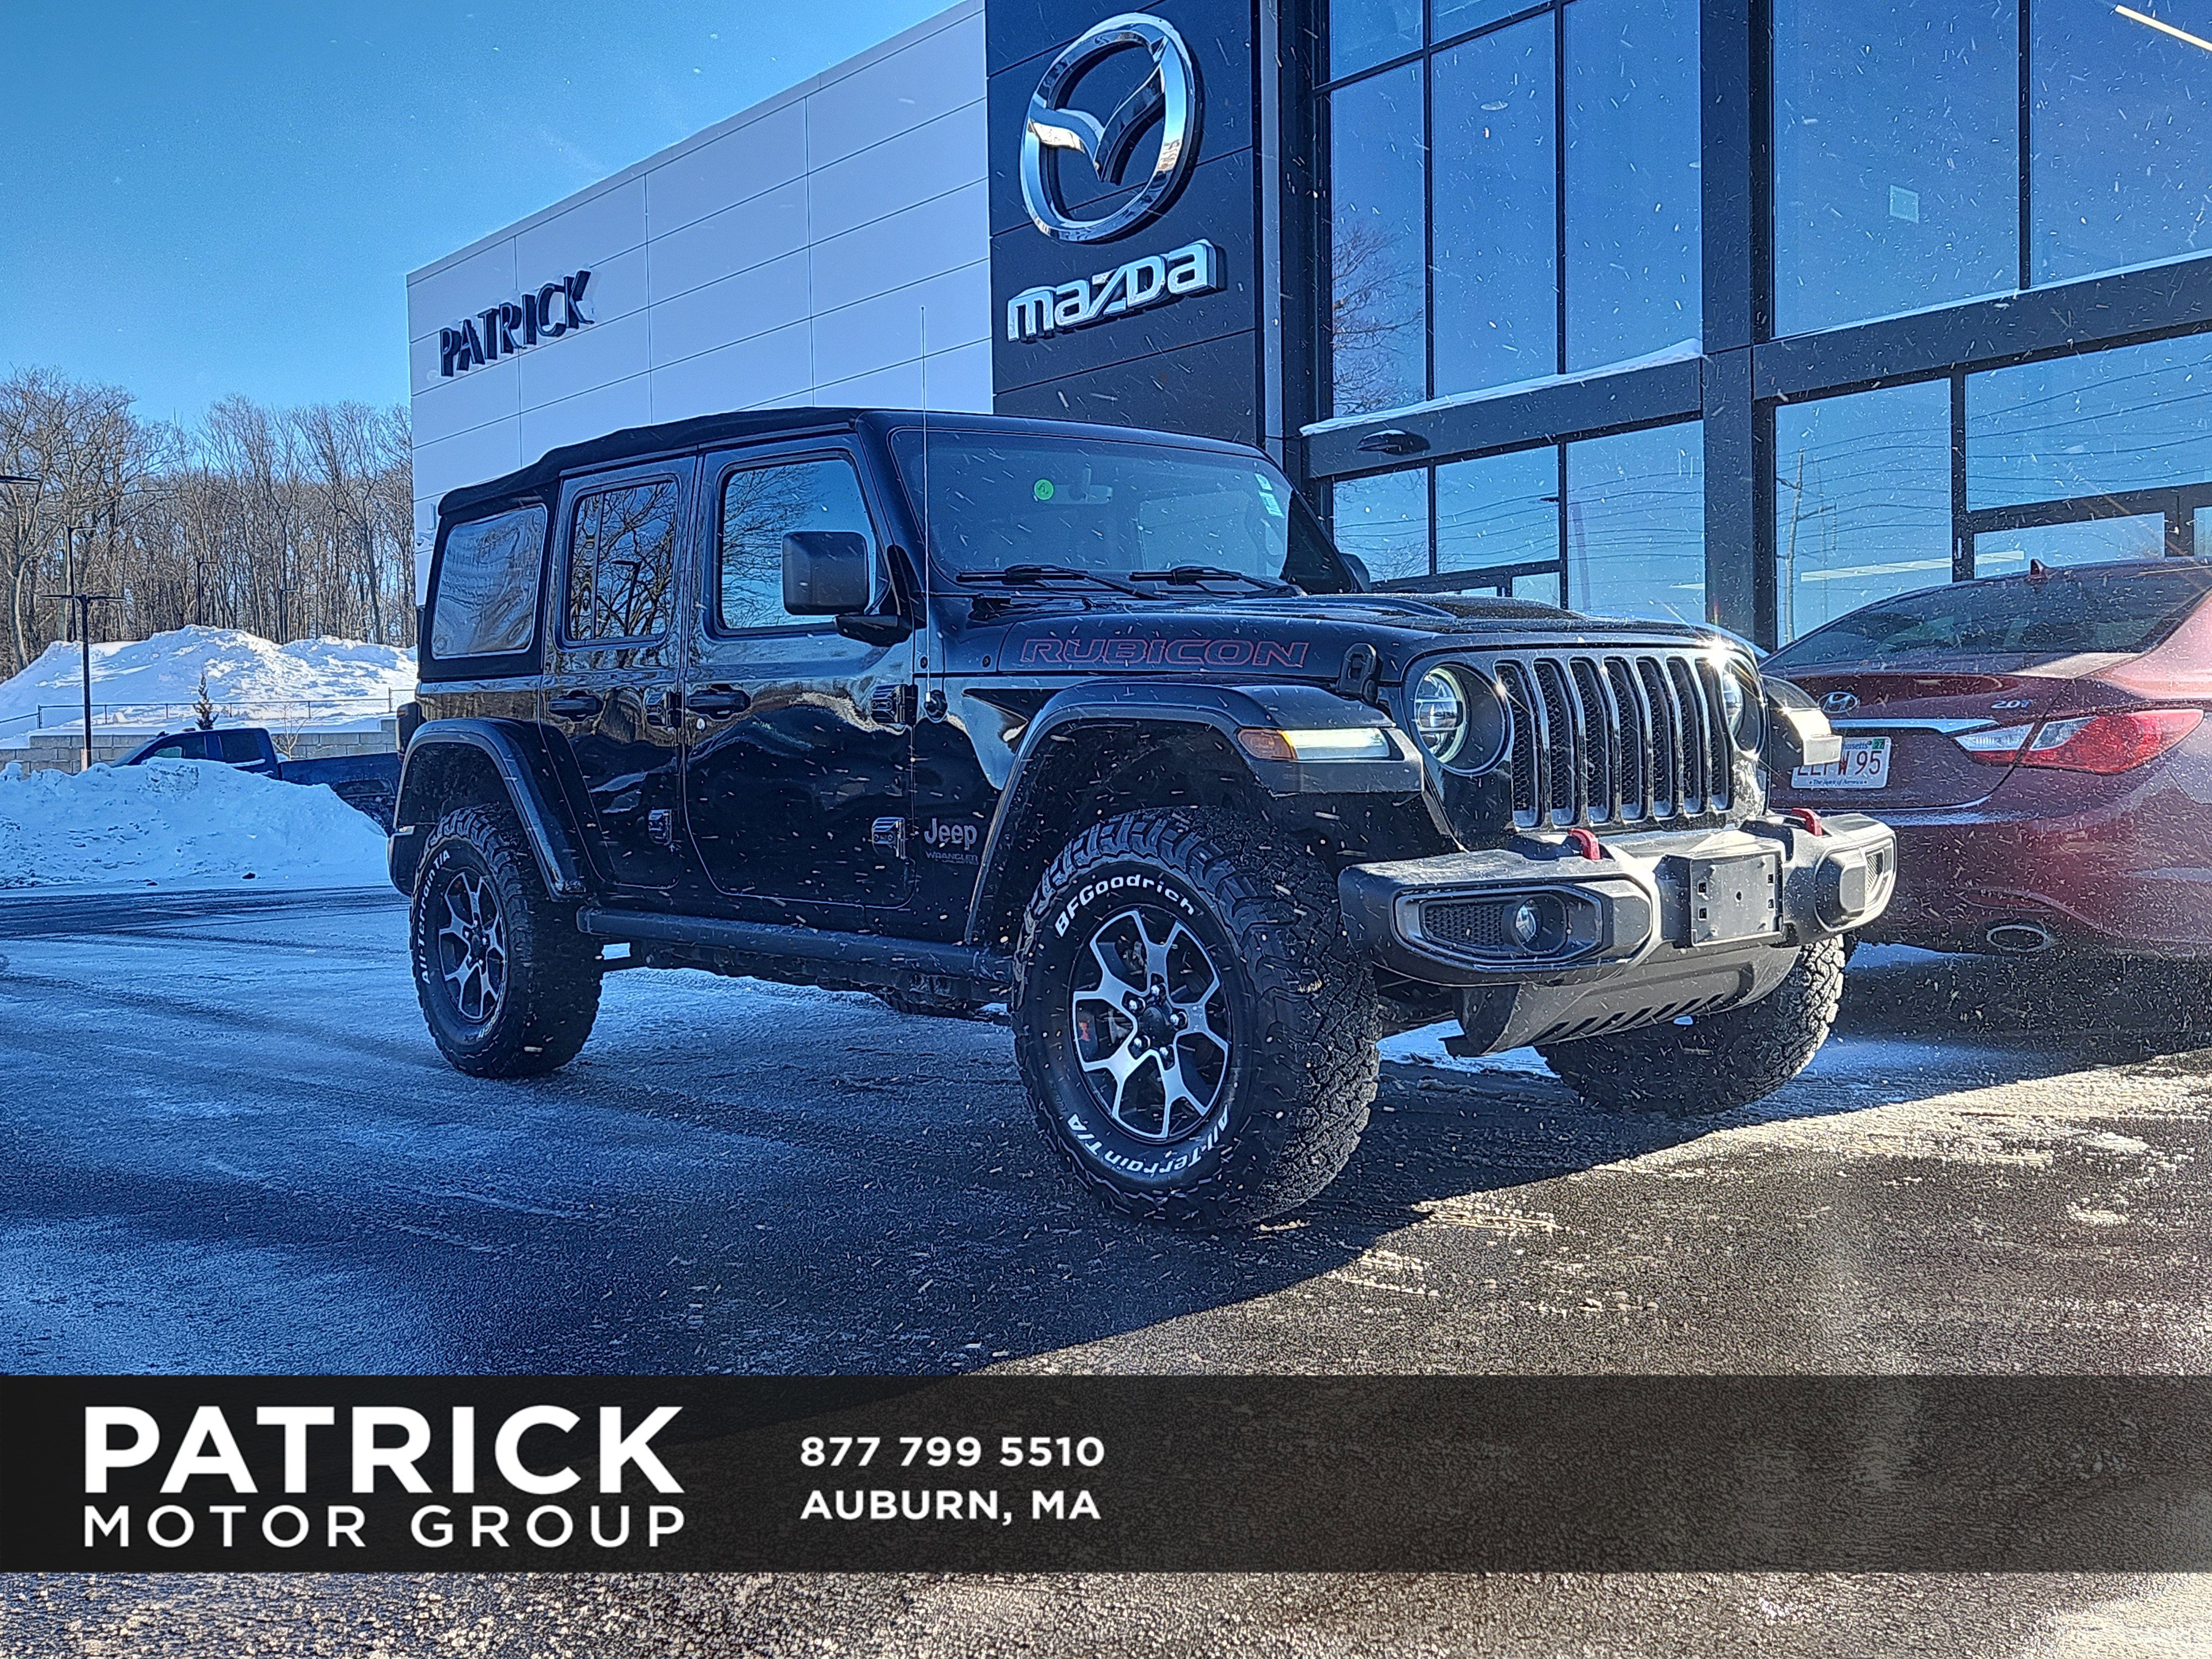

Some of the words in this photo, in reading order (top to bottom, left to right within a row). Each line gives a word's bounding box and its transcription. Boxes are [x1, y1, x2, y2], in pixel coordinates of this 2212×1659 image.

[440, 270, 595, 376] PATRICK
[1020, 639, 1309, 667] RUBICON
[1854, 750, 1882, 775] 95
[924, 818, 978, 851] Jeep
[925, 851, 979, 861] WRANGLER
[417, 871, 435, 985] All-Terrain
[433, 849, 451, 870] T/A
[1054, 874, 1194, 937] BFGoodrich
[1067, 1113, 1103, 1155] T/A
[1104, 1104, 1229, 1178] All-Terrain
